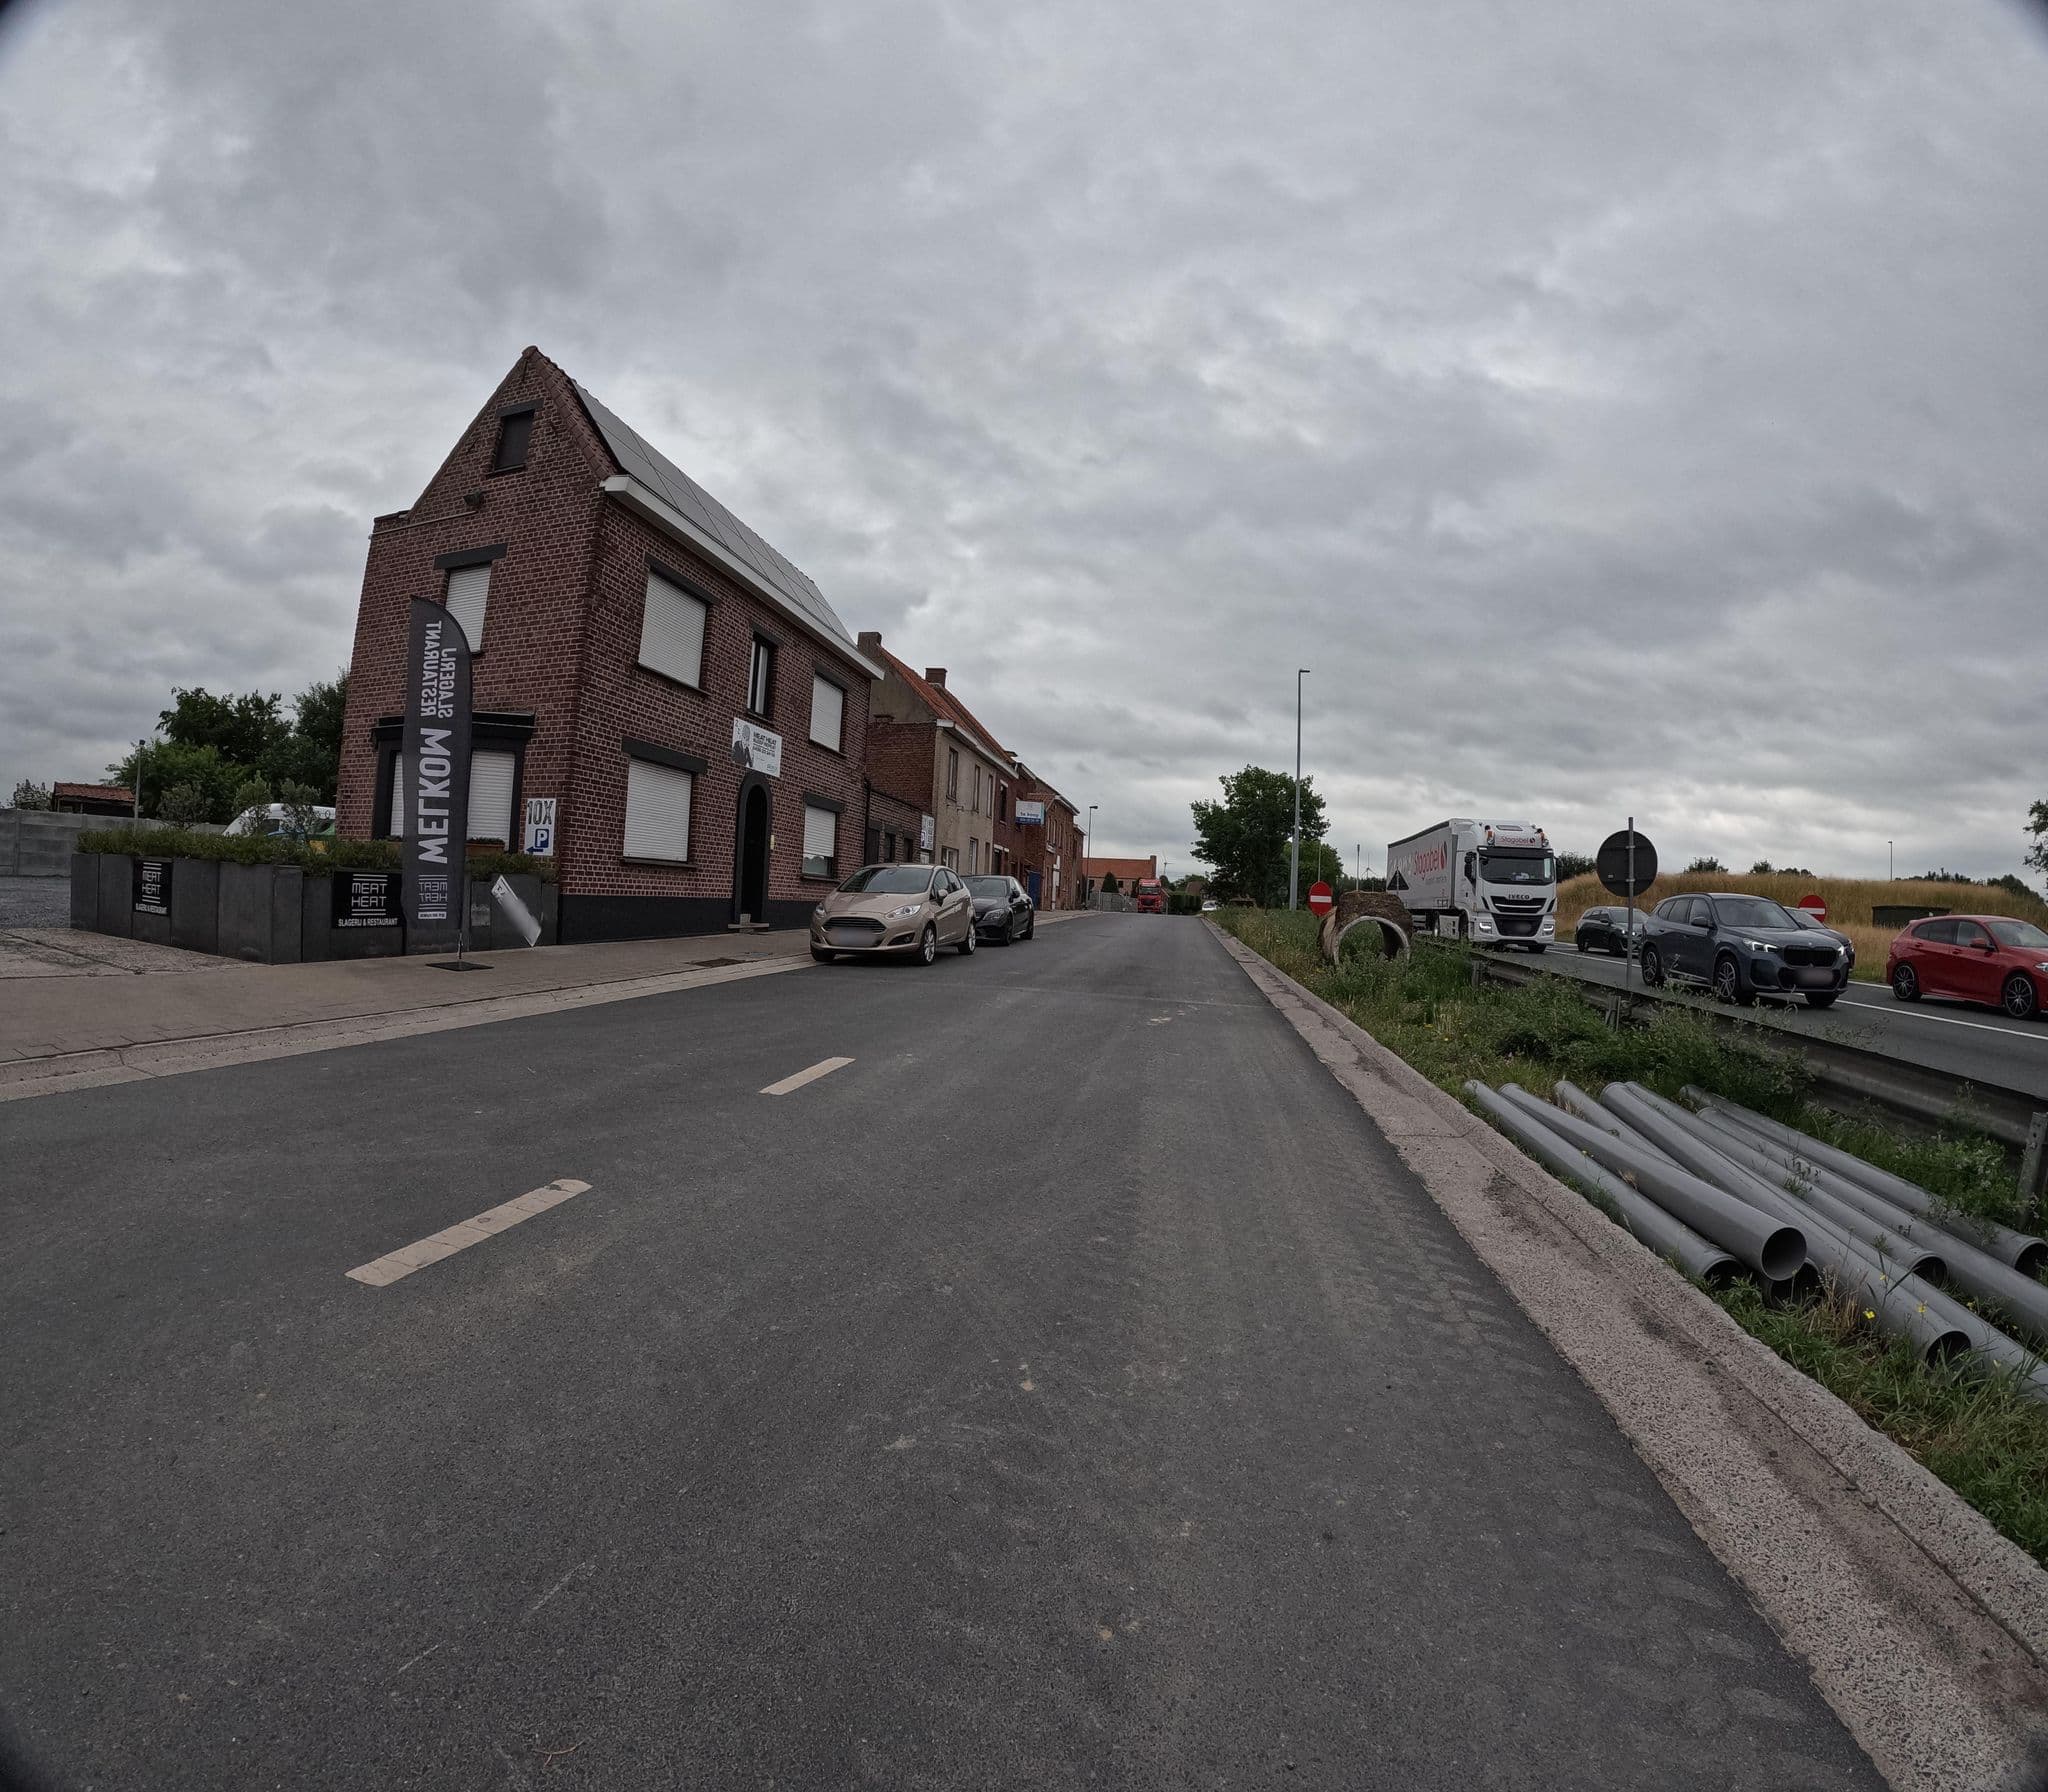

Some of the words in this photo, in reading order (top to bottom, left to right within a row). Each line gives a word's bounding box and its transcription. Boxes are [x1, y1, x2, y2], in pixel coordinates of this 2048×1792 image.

[527, 800, 554, 825] 10X
[536, 830, 548, 847] P
[142, 870, 162, 883] MEAT
[141, 883, 161, 896] HEAT
[352, 882, 388, 894] MEAT
[351, 896, 387, 907] HEAT
[367, 917, 398, 926] RESTAURANT
